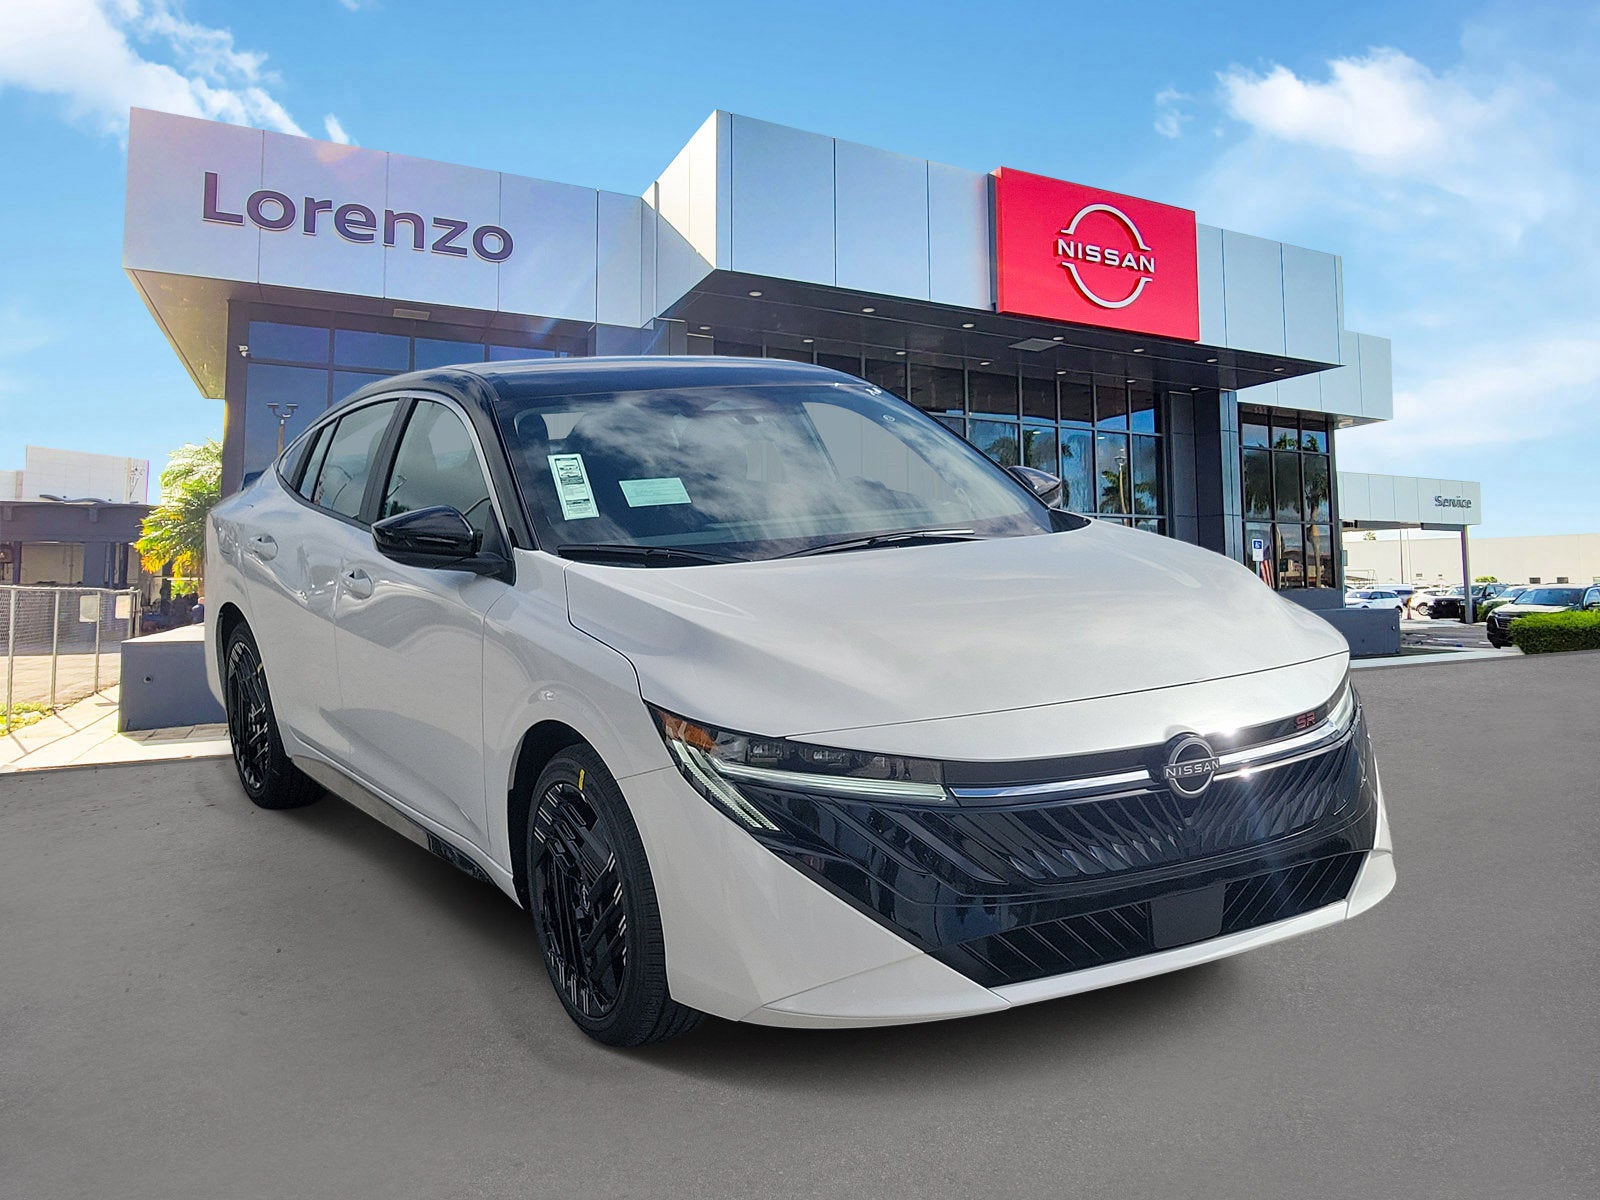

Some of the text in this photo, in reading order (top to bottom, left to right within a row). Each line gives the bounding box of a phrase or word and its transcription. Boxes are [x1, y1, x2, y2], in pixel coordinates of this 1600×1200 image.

[203, 171, 514, 262] Lorenzo
[1057, 238, 1155, 273] NISSAN
[1434, 495, 1472, 509] Service
[1295, 711, 1316, 730] SR
[1165, 759, 1220, 777] NISSAN
